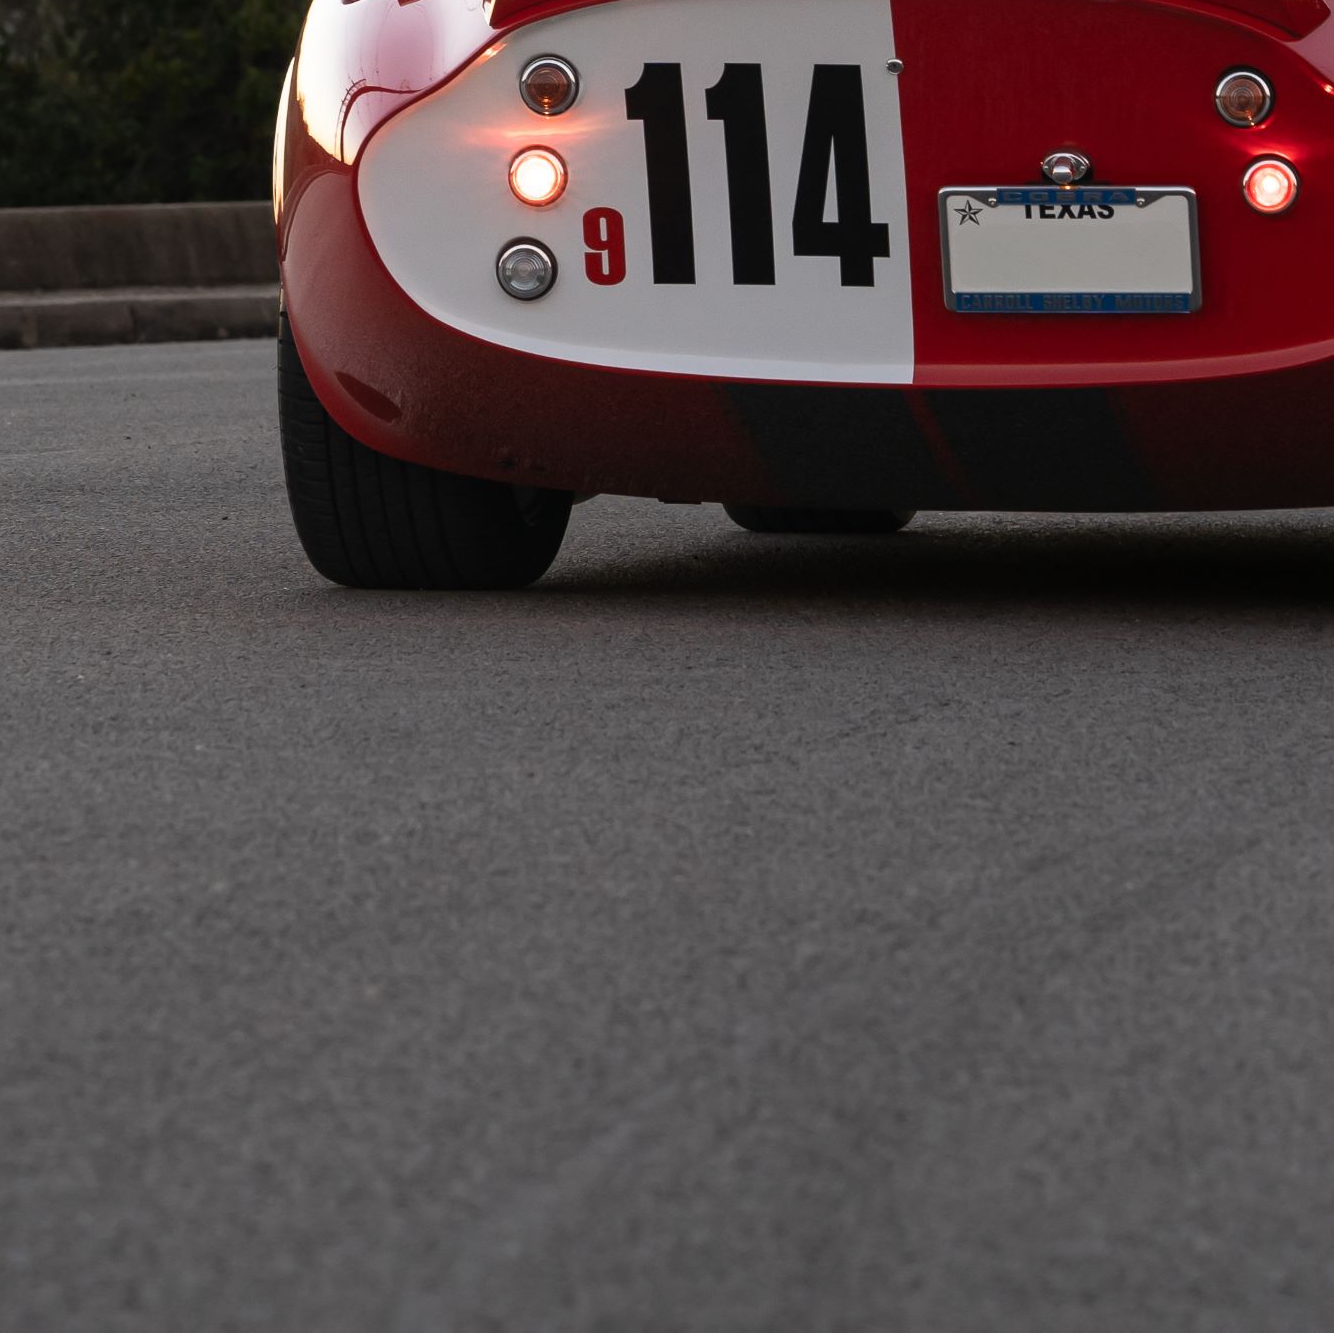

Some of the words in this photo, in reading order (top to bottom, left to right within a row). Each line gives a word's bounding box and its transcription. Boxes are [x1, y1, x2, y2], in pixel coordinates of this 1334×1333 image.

[624, 62, 891, 287] 114
[1002, 191, 1131, 203] COBRA
[1024, 204, 1115, 219] TEXAS
[582, 207, 627, 286] 9
[960, 294, 1033, 309] CARROLL
[1042, 294, 1105, 309] SHELBY
[1115, 294, 1185, 309] MOTORS
